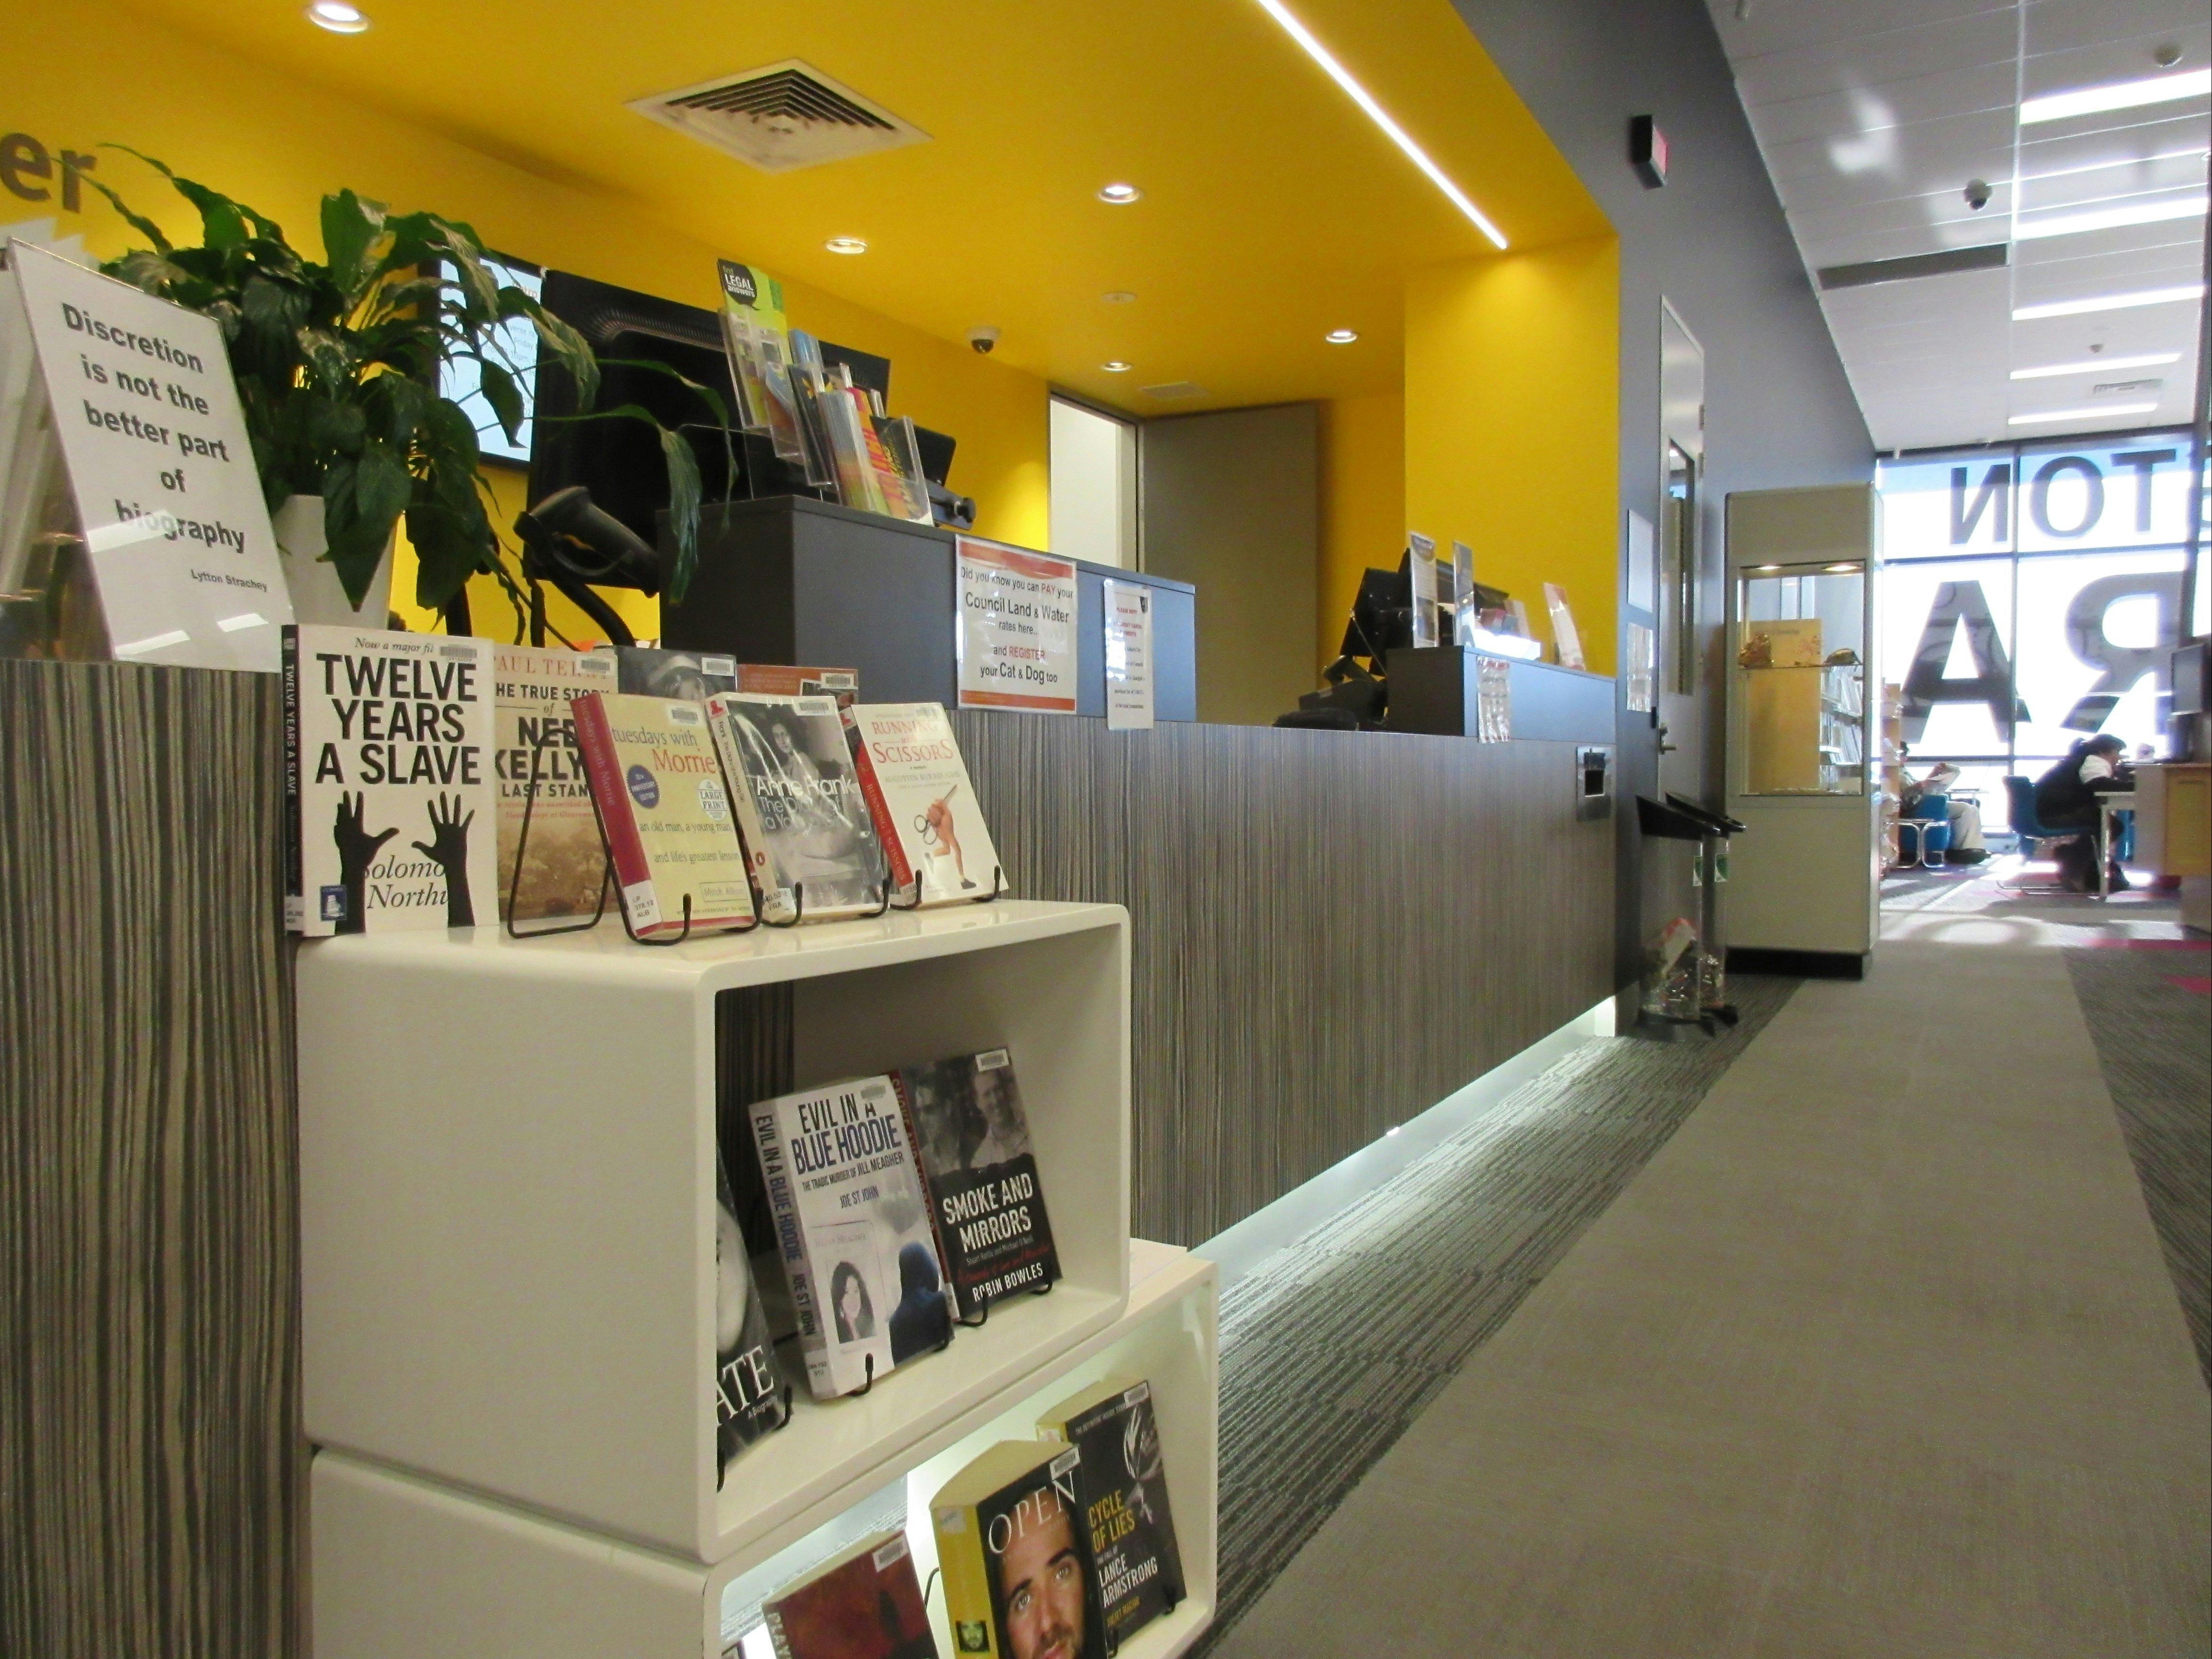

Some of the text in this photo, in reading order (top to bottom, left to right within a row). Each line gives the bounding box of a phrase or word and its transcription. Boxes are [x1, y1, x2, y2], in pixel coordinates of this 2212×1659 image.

[725, 274, 754, 291] LEGAL
[728, 285, 755, 298] answers
[62, 302, 204, 373] Discretion
[80, 353, 210, 416] is not the
[83, 398, 230, 463] better part
[160, 468, 186, 493] of
[115, 498, 246, 553] biography
[191, 569, 268, 592] Lytton Strachey
[960, 567, 1074, 599] Did you know you can PAY your
[965, 592, 1070, 623] Council Land & Water
[999, 621, 1040, 635] rates here...
[355, 637, 382, 649] Now
[392, 642, 422, 653] major
[424, 642, 435, 653] fil
[993, 645, 1046, 661] and REGISTER
[494, 655, 537, 673] AUL
[980, 662, 1058, 685] your Cat & Dog too
[316, 653, 478, 702] TWELVE
[496, 682, 609, 701] HE TRUE STO
[332, 699, 465, 743] YEARS
[543, 702, 555, 717] of
[285, 664, 297, 795] TWELVE YEARS A SLAVE
[611, 727, 698, 748] tuesdays with
[718, 721, 726, 739] Frank
[575, 698, 619, 807] tuesdays with Morrie
[651, 747, 717, 774] Morrie
[873, 739, 954, 763] SCISSORS
[315, 743, 481, 785] A SLAVE
[502, 783, 588, 798] LAST STAN
[700, 790, 724, 800] LARGE
[756, 775, 804, 796] Anne
[702, 801, 726, 809] PRINT
[757, 796, 784, 813] The
[640, 823, 649, 832] an
[651, 821, 663, 831] old
[665, 823, 684, 833] man,
[692, 823, 715, 834] young
[867, 783, 907, 880] RUNNING SCISSORS
[363, 854, 445, 879] olomo
[654, 850, 740, 864] and life's greatest lesson
[368, 883, 450, 909] Northu
[704, 888, 723, 897] Mitch
[637, 910, 650, 919] ALB
[769, 902, 781, 911] FRA
[798, 1093, 876, 1134] EVIL IN A
[791, 1114, 902, 1175] BLUE HOODIE
[802, 1152, 905, 1192] THE TRAGIC MURDER OF JILL MEAGHER
[755, 1113, 803, 1264] EVIL IN A BLUE HOODIE
[840, 1184, 879, 1209] JOE ST JOHN
[943, 1183, 999, 1225] SMOKE
[1001, 1173, 1033, 1206] AND
[959, 1205, 1032, 1253] MIRRORS
[972, 1277, 1003, 1302] ROBIN
[1004, 1262, 1043, 1289] BOWLES
[792, 1273, 817, 1336] JOE ST JOHN
[717, 1345, 774, 1426] ATE
[1075, 1427, 1083, 1436] THE
[989, 1470, 1076, 1554] OPEN
[1088, 1489, 1125, 1528] CYCLE
[1092, 1509, 1136, 1553] OF LIES
[1104, 1551, 1112, 1559] FALL
[1098, 1553, 1128, 1588] LANCE
[1102, 1556, 1159, 1608] ARMSTRONG
